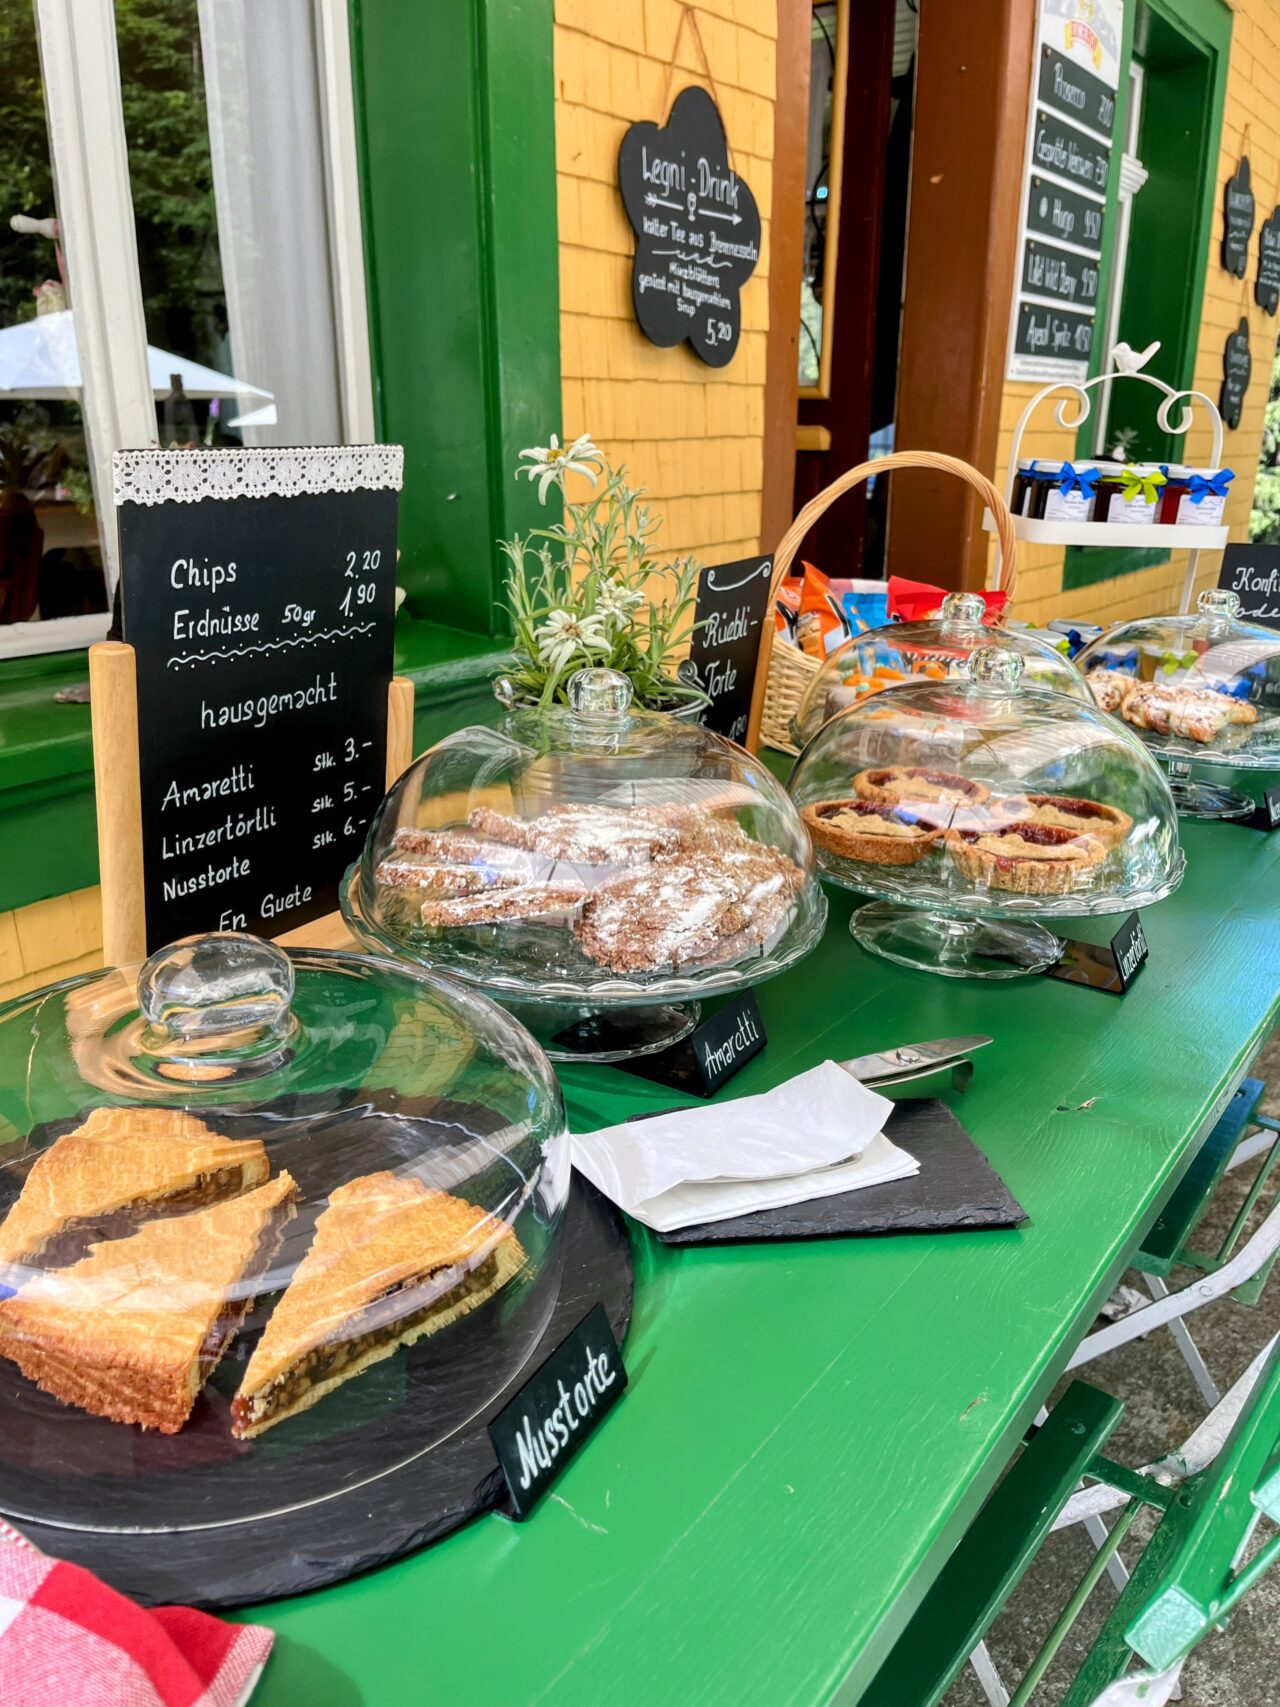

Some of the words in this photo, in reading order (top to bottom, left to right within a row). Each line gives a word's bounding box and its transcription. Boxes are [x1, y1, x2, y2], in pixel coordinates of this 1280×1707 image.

[642, 146, 686, 197] Legni
[698, 157, 740, 210] Drink
[669, 220, 686, 244] Tee
[688, 232, 704, 248] aus
[171, 558, 237, 593] Chips
[344, 550, 381, 579] 2.20
[1232, 566, 1280, 598] Konfi
[173, 606, 260, 640] Erdnüsse
[339, 583, 376, 617] 1.90
[200, 672, 338, 729] hausgemacht
[705, 658, 737, 697] Torte
[161, 764, 255, 811] Amaretti
[162, 805, 277, 860] Linzertörtli
[163, 856, 251, 902] Nusstorte
[219, 909, 248, 934] En
[260, 884, 313, 920] Guete
[704, 1009, 760, 1080] Amaretti
[515, 1345, 616, 1490] Nusstorte
